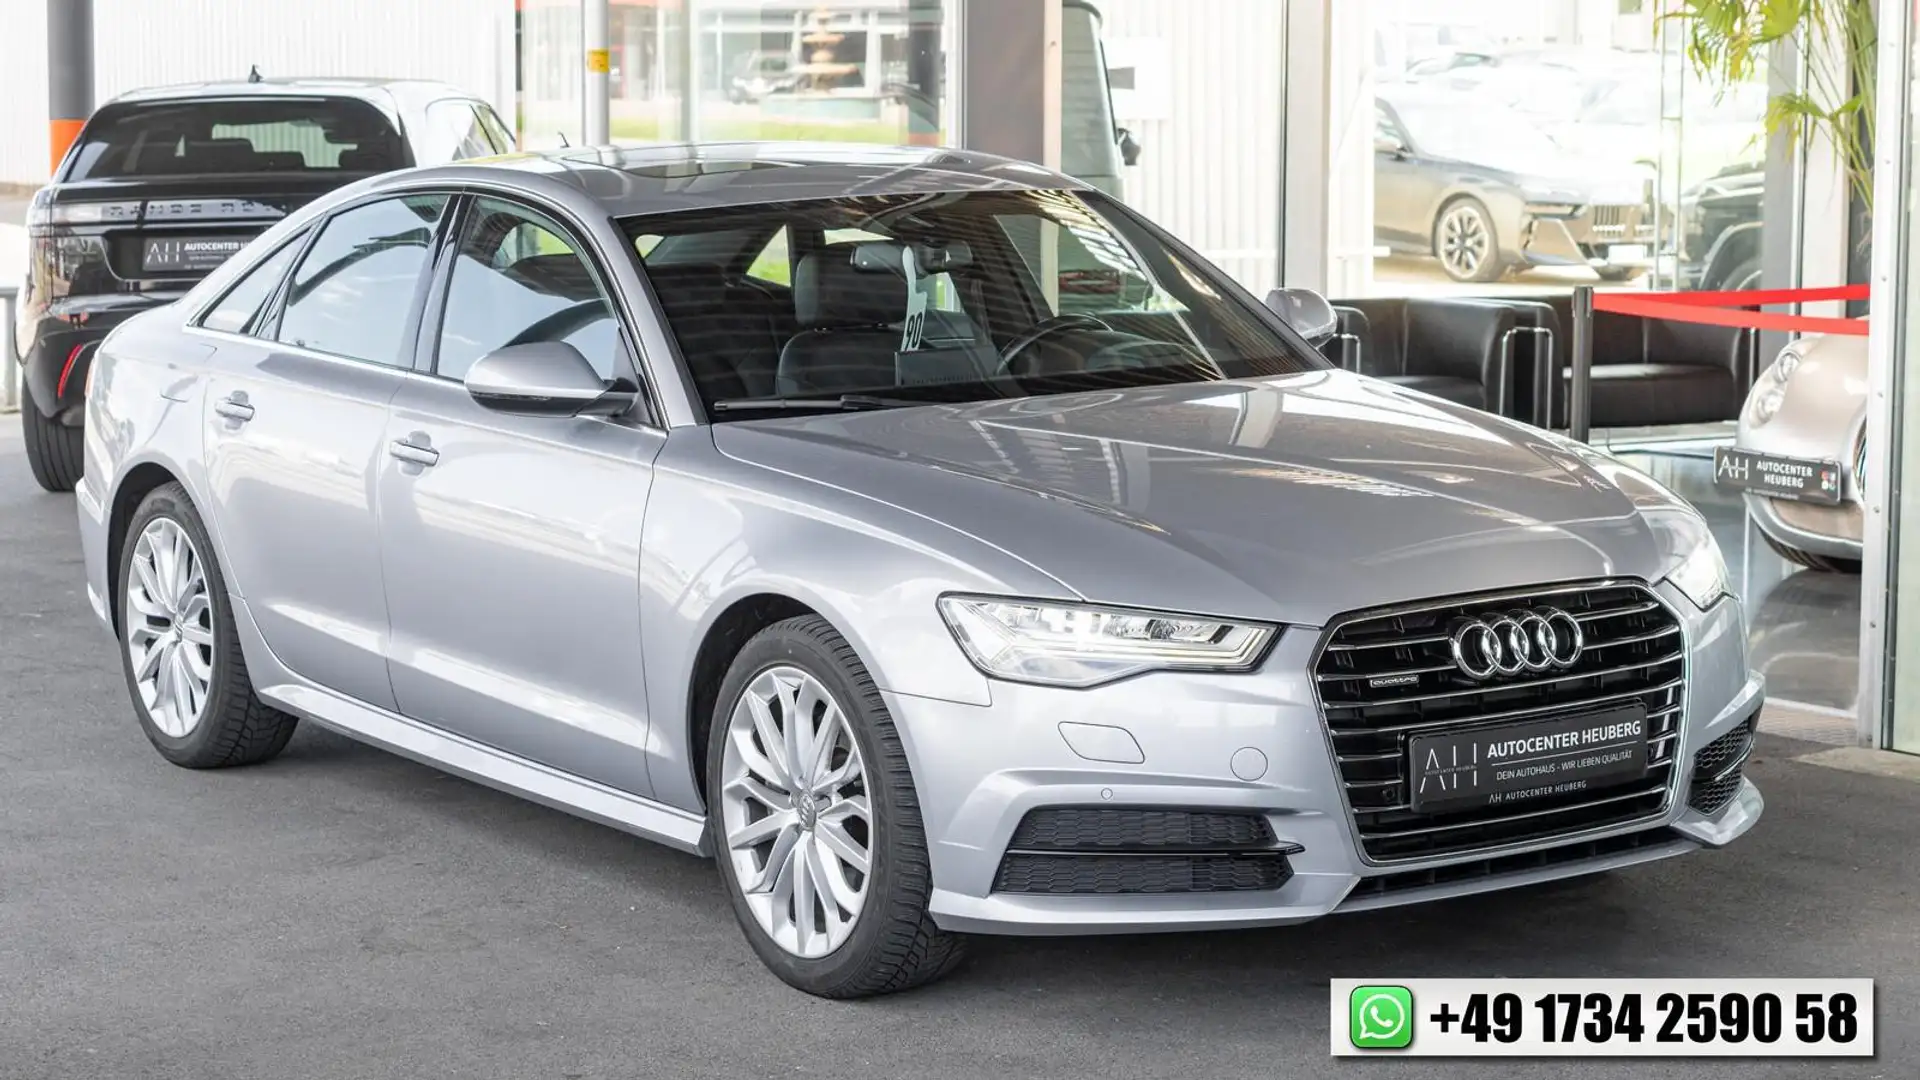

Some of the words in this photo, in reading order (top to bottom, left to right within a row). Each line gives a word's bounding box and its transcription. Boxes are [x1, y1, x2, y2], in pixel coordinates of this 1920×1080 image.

[184, 242, 239, 251] AUTOCENTER
[904, 311, 923, 351] 90
[1718, 455, 1749, 480] AH
[1756, 460, 1813, 477] AUTOCENTER
[1763, 473, 1804, 488] HEUBERG
[1372, 675, 1418, 687] quattro
[1487, 731, 1579, 758] AUTOCENTER
[1581, 720, 1641, 744] HEUBERG
[1496, 770, 1515, 780] DEIN
[1516, 763, 1556, 778] AUTOHAUS
[1561, 760, 1576, 771] WIR
[1577, 756, 1601, 768] LIEBEN
[1602, 749, 1633, 764] QUALITÄT
[1489, 793, 1502, 804] AH
[1506, 785, 1553, 800] AUTOCENTER
[1555, 780, 1587, 792] HEUBERG
